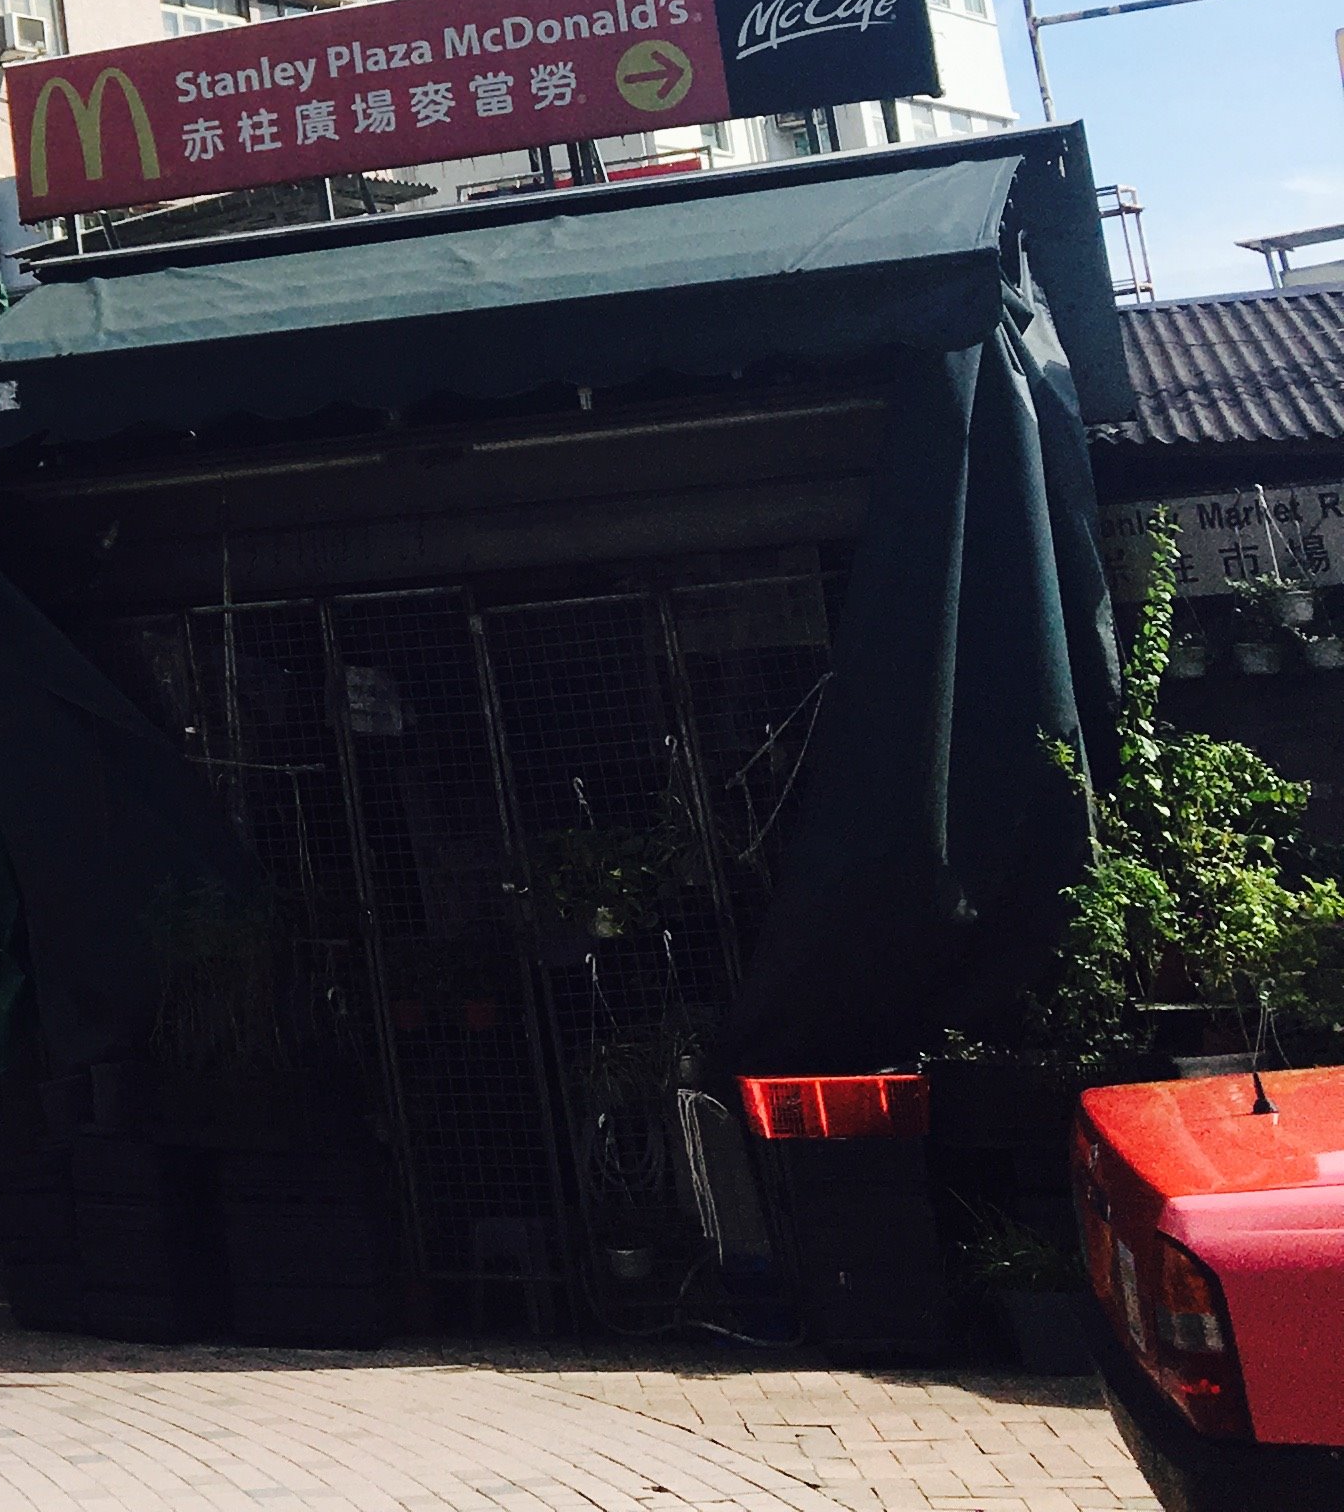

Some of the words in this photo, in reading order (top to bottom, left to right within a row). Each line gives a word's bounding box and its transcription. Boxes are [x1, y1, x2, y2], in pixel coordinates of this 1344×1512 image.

[175, 55, 317, 104] Stanley
[326, 38, 432, 79] Plaza
[182, 61, 579, 163] 赤柱廣場麥當勞
